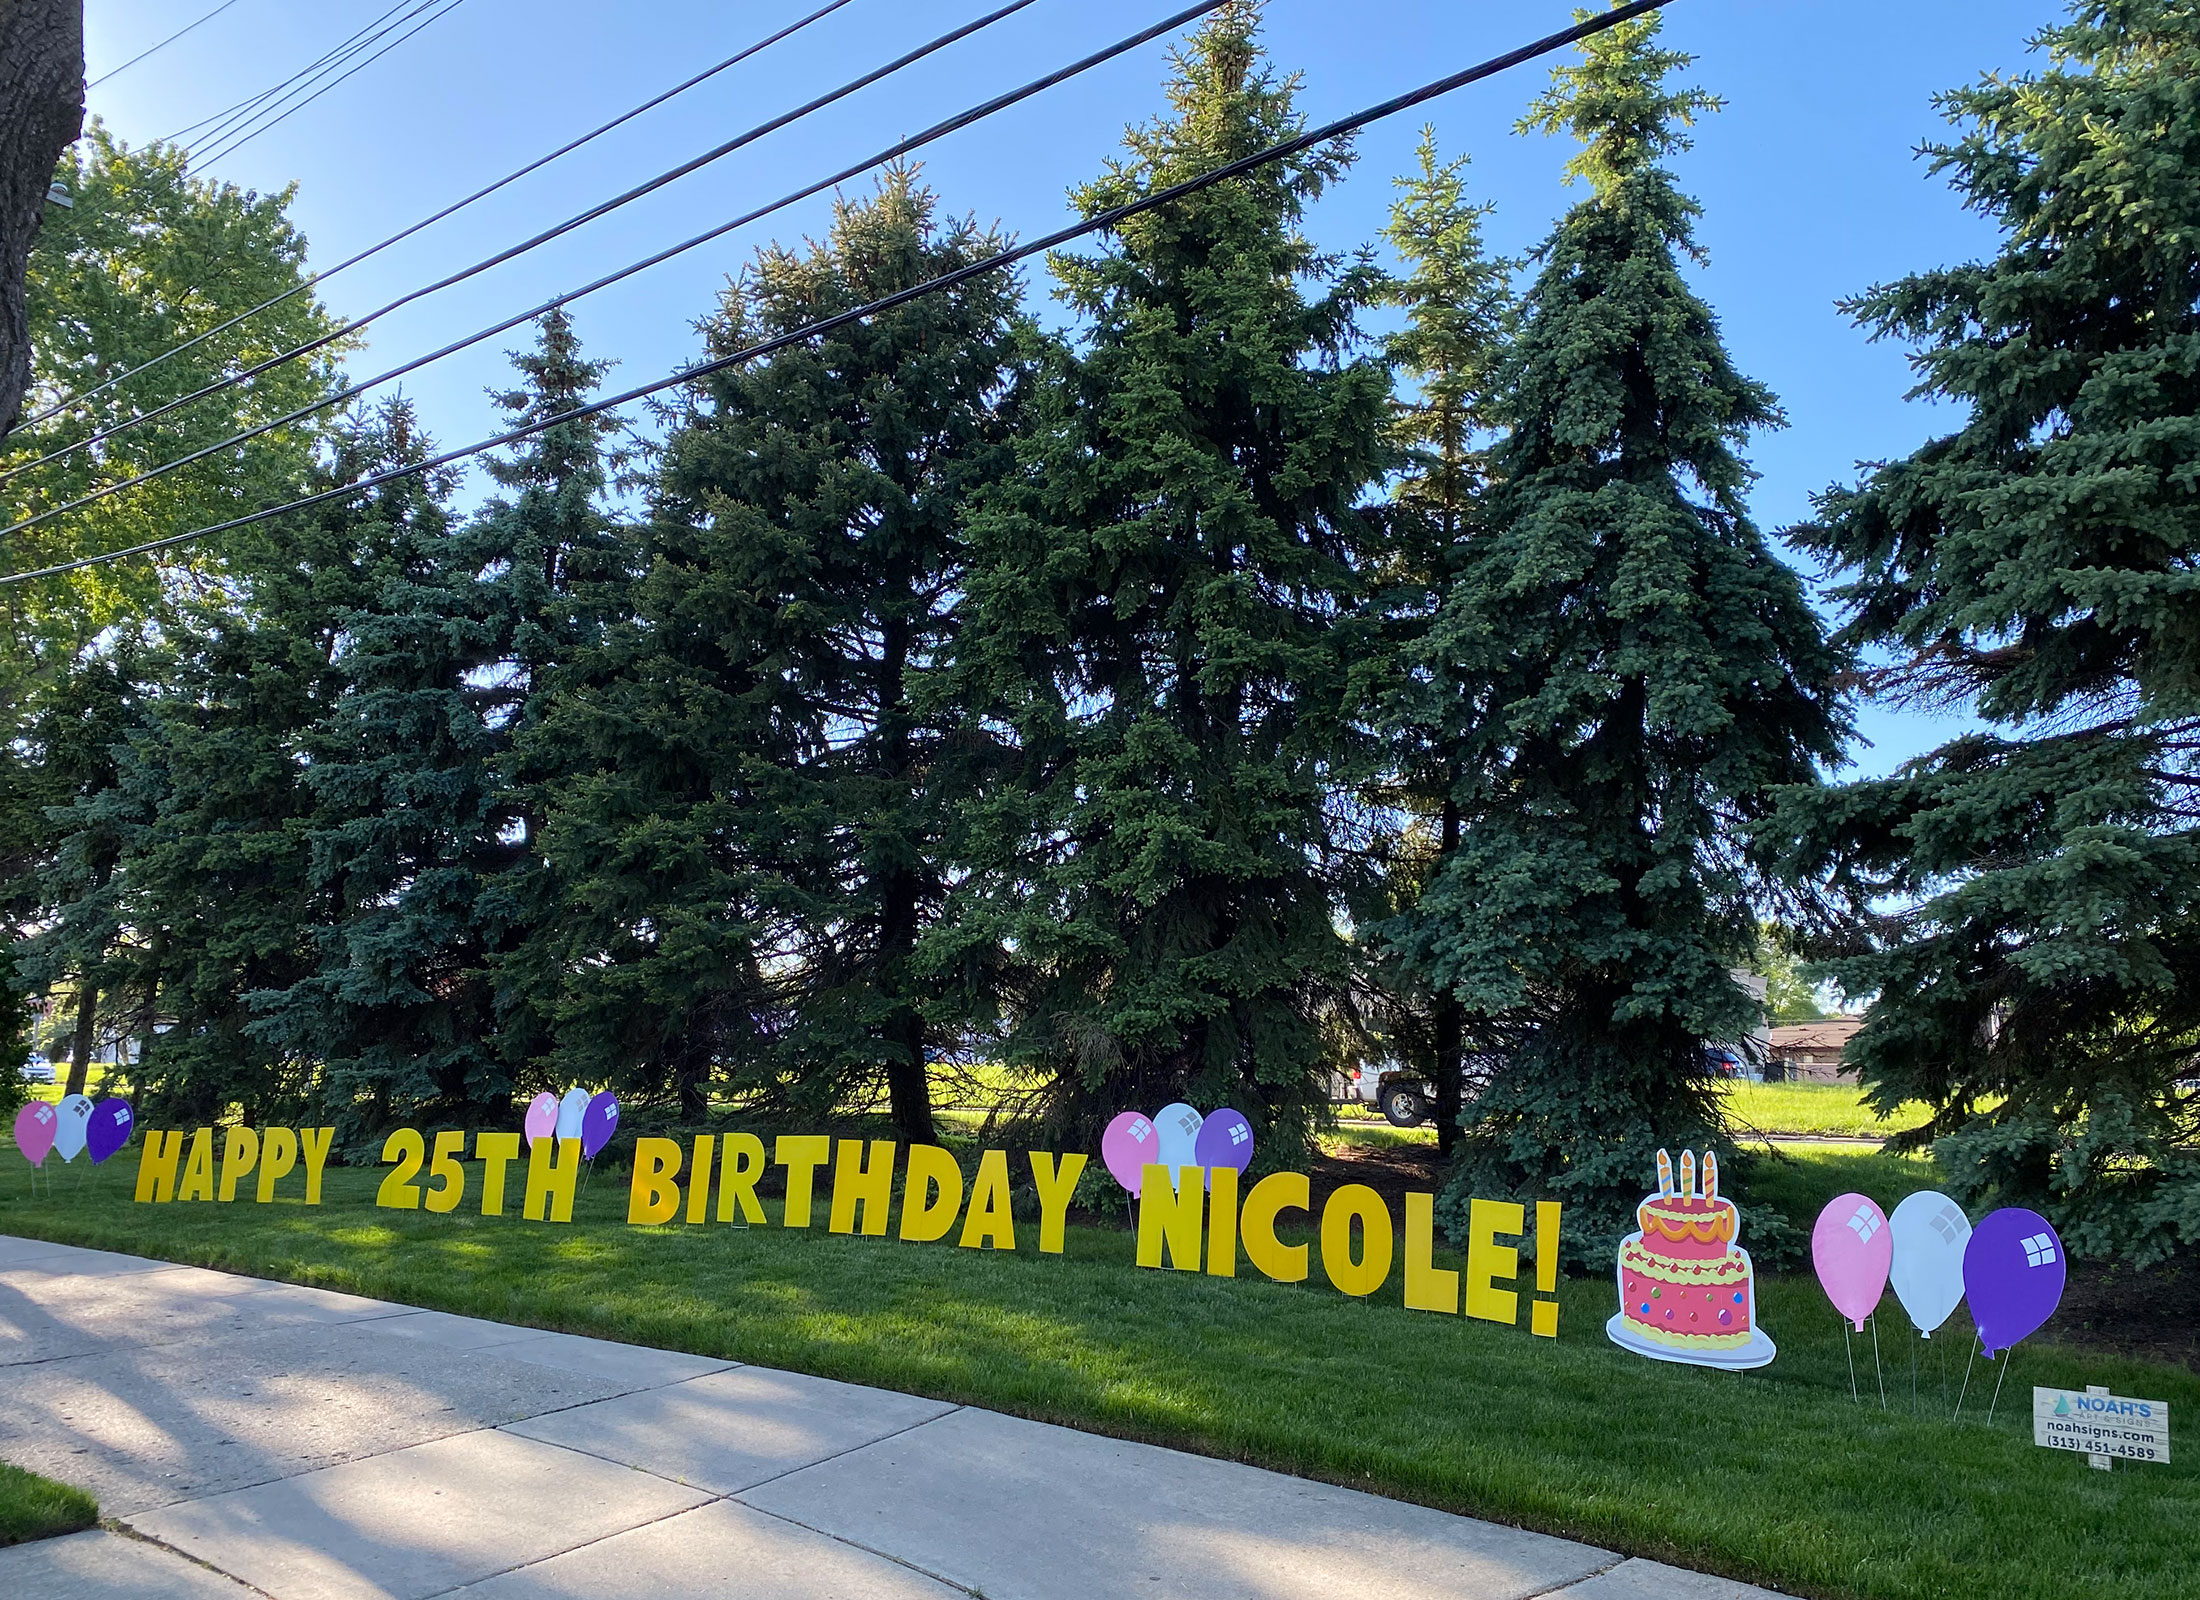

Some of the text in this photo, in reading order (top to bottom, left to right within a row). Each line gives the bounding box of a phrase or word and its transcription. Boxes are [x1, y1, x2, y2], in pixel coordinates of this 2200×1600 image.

[135, 1125, 1562, 1337] HAPPY 25TH BIRTHDAY NICOLE!
[2077, 1396, 2152, 1418] NOAH'S
[2047, 1421, 2154, 1444] noahsigns.com
[2115, 1417, 2151, 1428] SIGNS
[2047, 1435, 2155, 1460] (313) 451-4589
